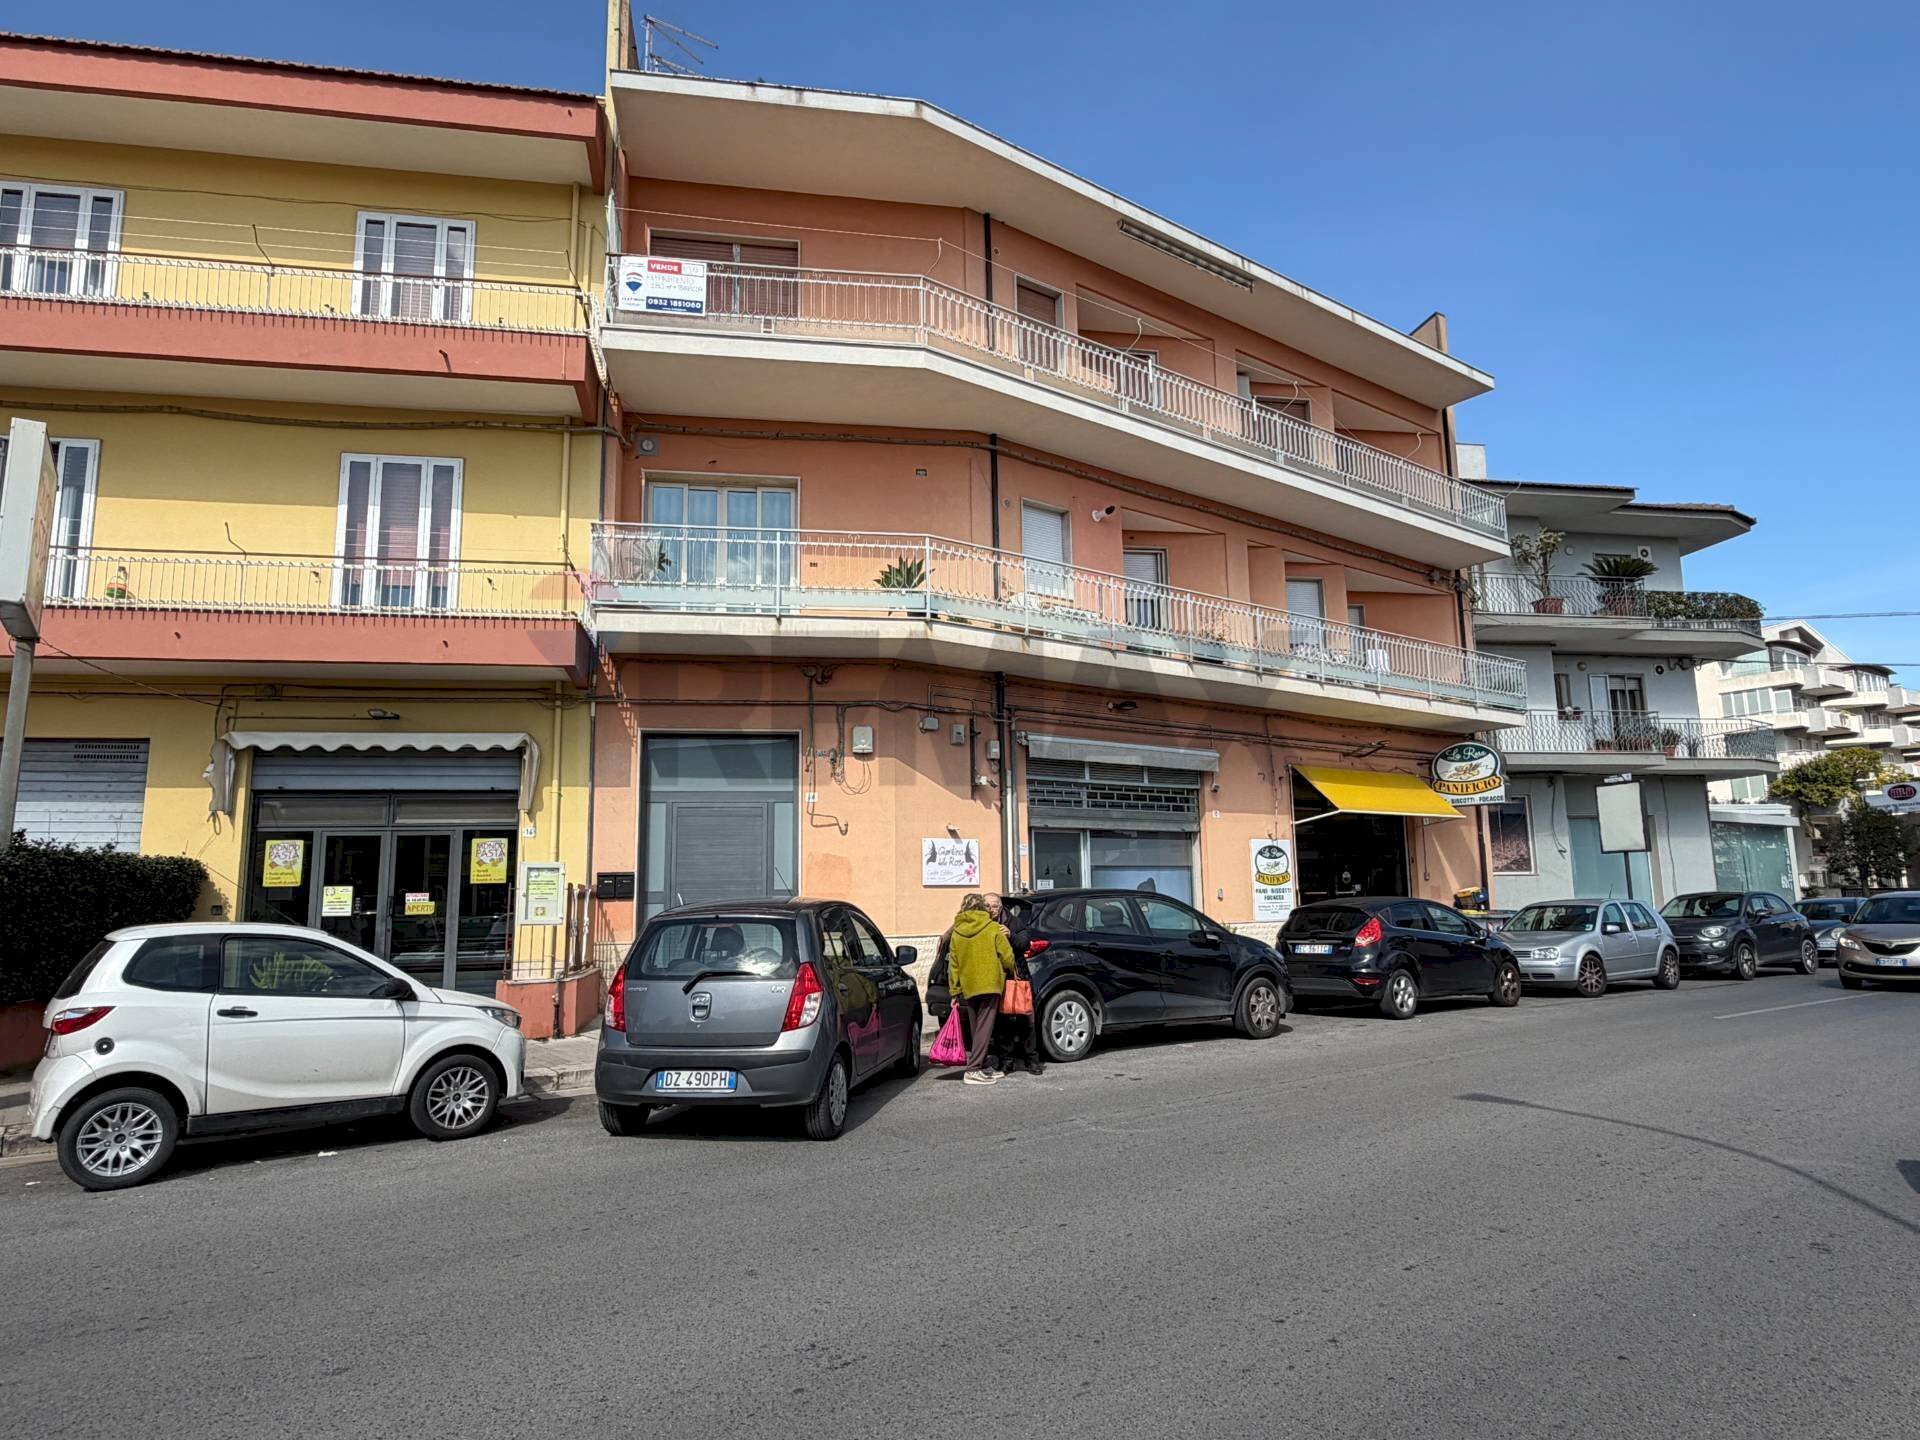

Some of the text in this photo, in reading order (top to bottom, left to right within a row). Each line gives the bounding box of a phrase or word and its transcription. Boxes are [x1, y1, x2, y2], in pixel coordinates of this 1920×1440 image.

[650, 263, 679, 272] VENDE
[647, 298, 668, 306] 0932
[1439, 777, 1497, 793] PANIFICIO
[269, 850, 300, 860] PASTA
[476, 849, 505, 857] PASTA
[407, 904, 433, 912] APERTO
[665, 1071, 727, 1087] DZ 490PH
